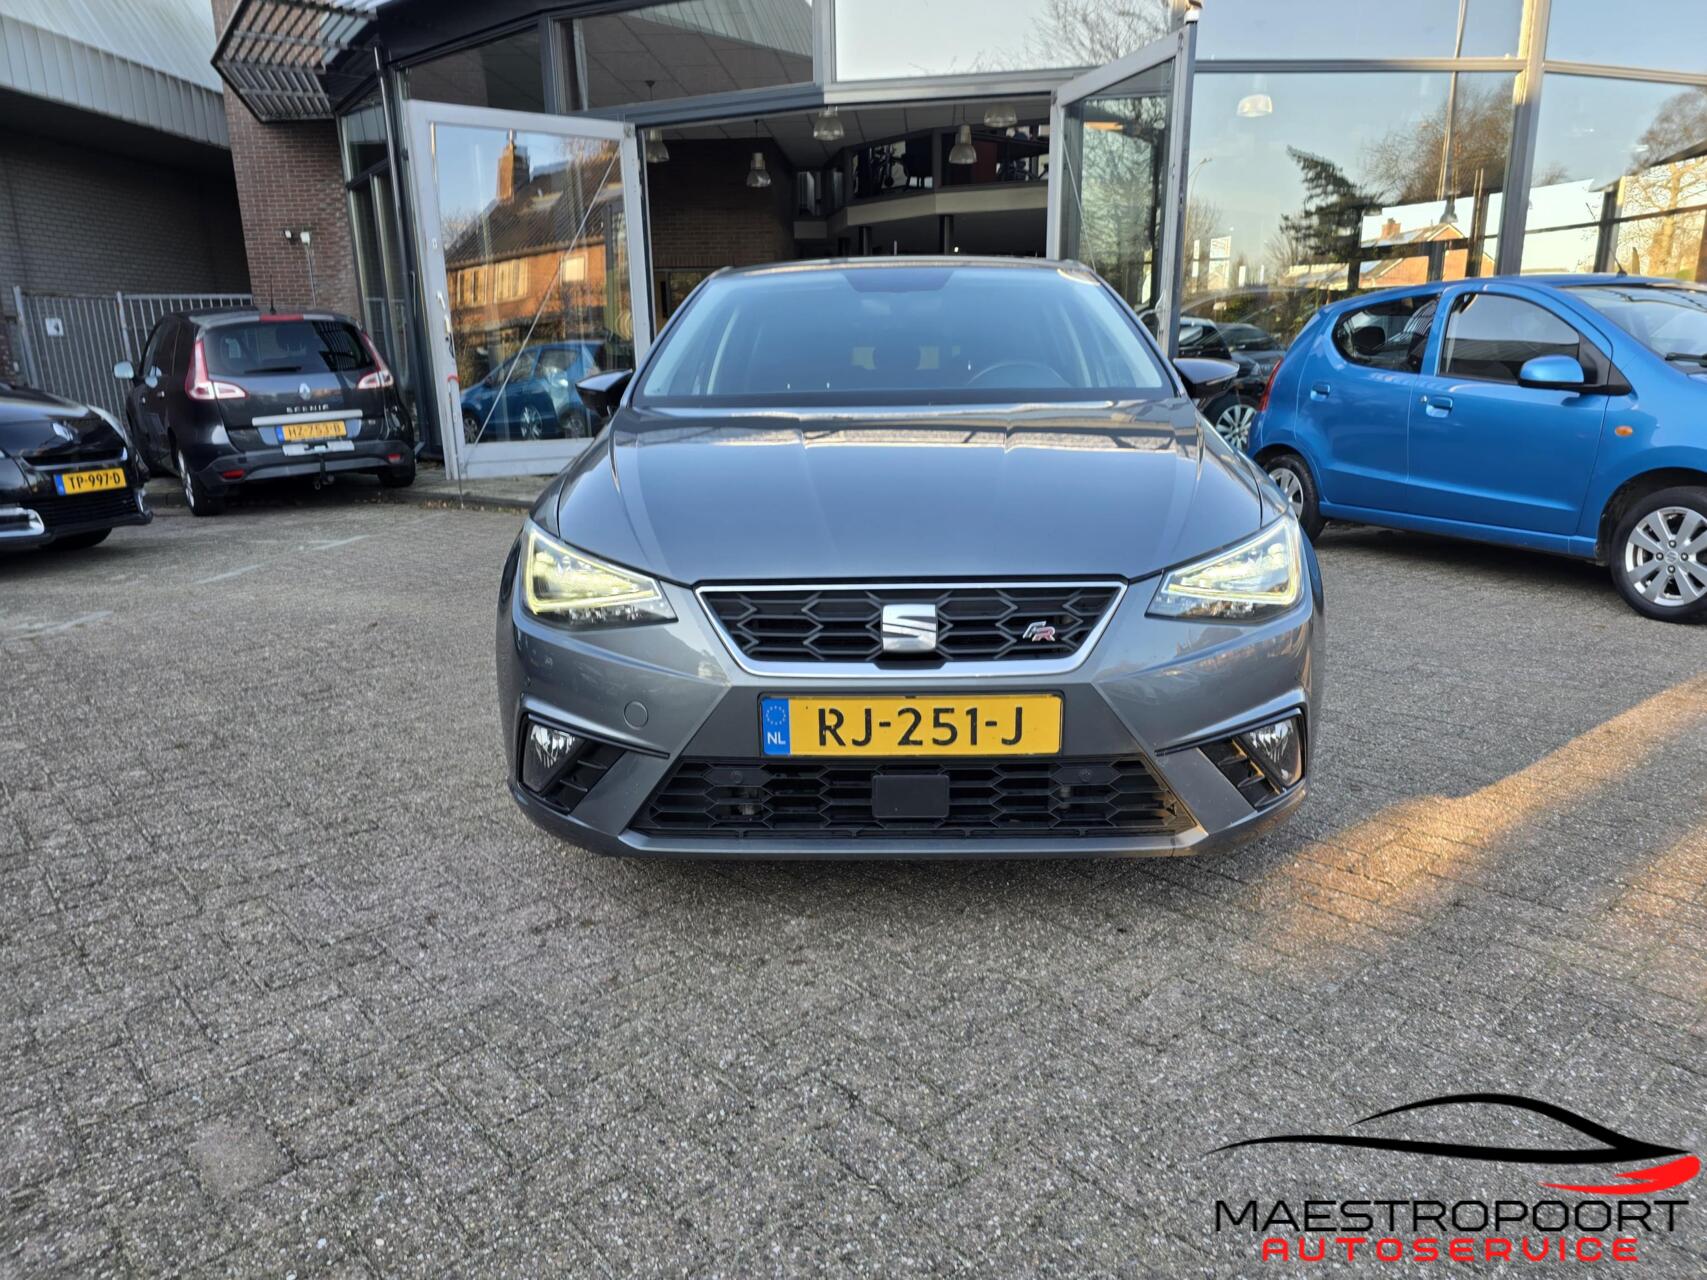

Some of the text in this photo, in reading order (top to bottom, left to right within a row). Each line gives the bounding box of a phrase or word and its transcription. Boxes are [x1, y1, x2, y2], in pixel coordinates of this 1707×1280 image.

[68, 471, 121, 489] TP-997-D
[818, 706, 1023, 746] RJ-251-J
[767, 732, 786, 745] NL
